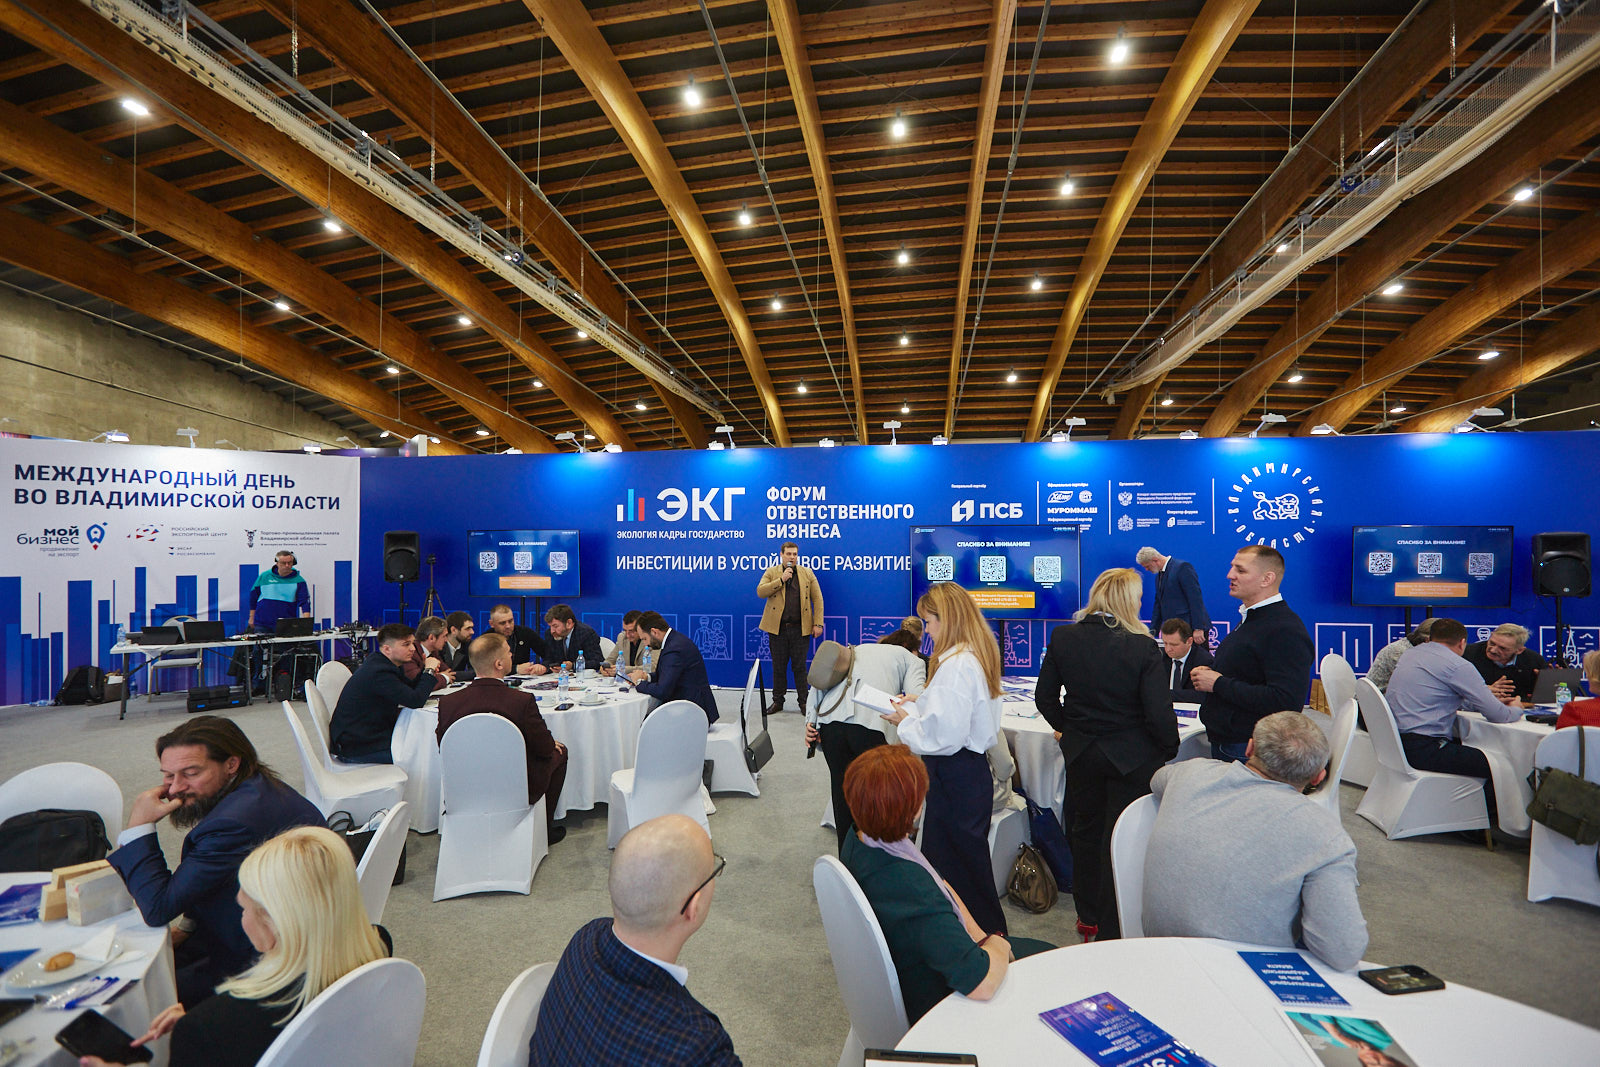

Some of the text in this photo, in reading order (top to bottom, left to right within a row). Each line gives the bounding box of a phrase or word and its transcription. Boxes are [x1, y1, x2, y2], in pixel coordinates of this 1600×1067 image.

[14, 464, 296, 490] МЕЖДУНАРОДНЫЙ ДЕНЬ
[14, 488, 340, 510] ВО ВЛАДИМИРСКОЙ ОБЛАСТИ
[766, 486, 826, 502] ФОРУМ
[656, 487, 746, 522] ЭКГ
[766, 504, 915, 520] ОТВЕТСТВЕННОГО
[979, 503, 1024, 519] ПСБ
[43, 525, 79, 536] мой
[616, 530, 745, 540] ЭКОЛОГИЯ КАДРЫ ГОСУДАРСТВО
[766, 523, 842, 539] БИЗНЕСА
[17, 533, 80, 545] бизнес
[616, 552, 911, 573] ИНВЕСТИЦИИ В УСТОЙВОЕ РАЗВИТИЕ
